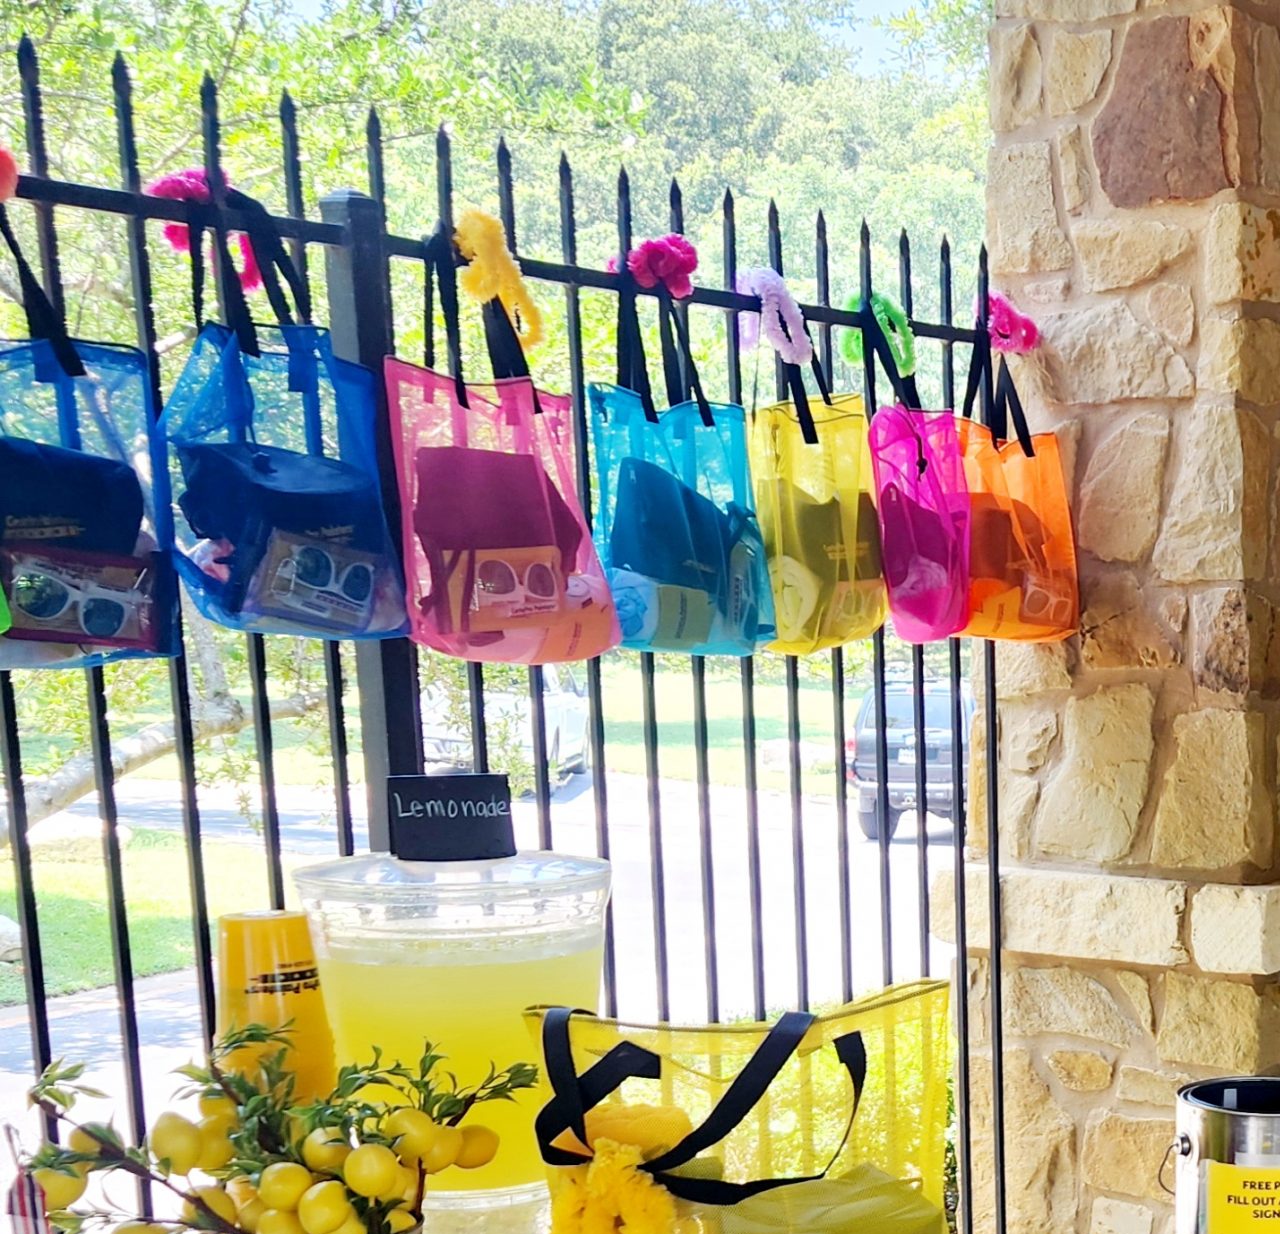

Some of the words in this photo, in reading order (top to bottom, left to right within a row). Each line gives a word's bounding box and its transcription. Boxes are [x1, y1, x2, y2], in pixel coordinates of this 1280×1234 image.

[394, 793, 510, 818] Lemonade
[1242, 1180, 1272, 1190] FREE
[1227, 1195, 1249, 1206] FILL
[1252, 1196, 1276, 1206] OUT
[1252, 1208, 1280, 1219] SIGN
